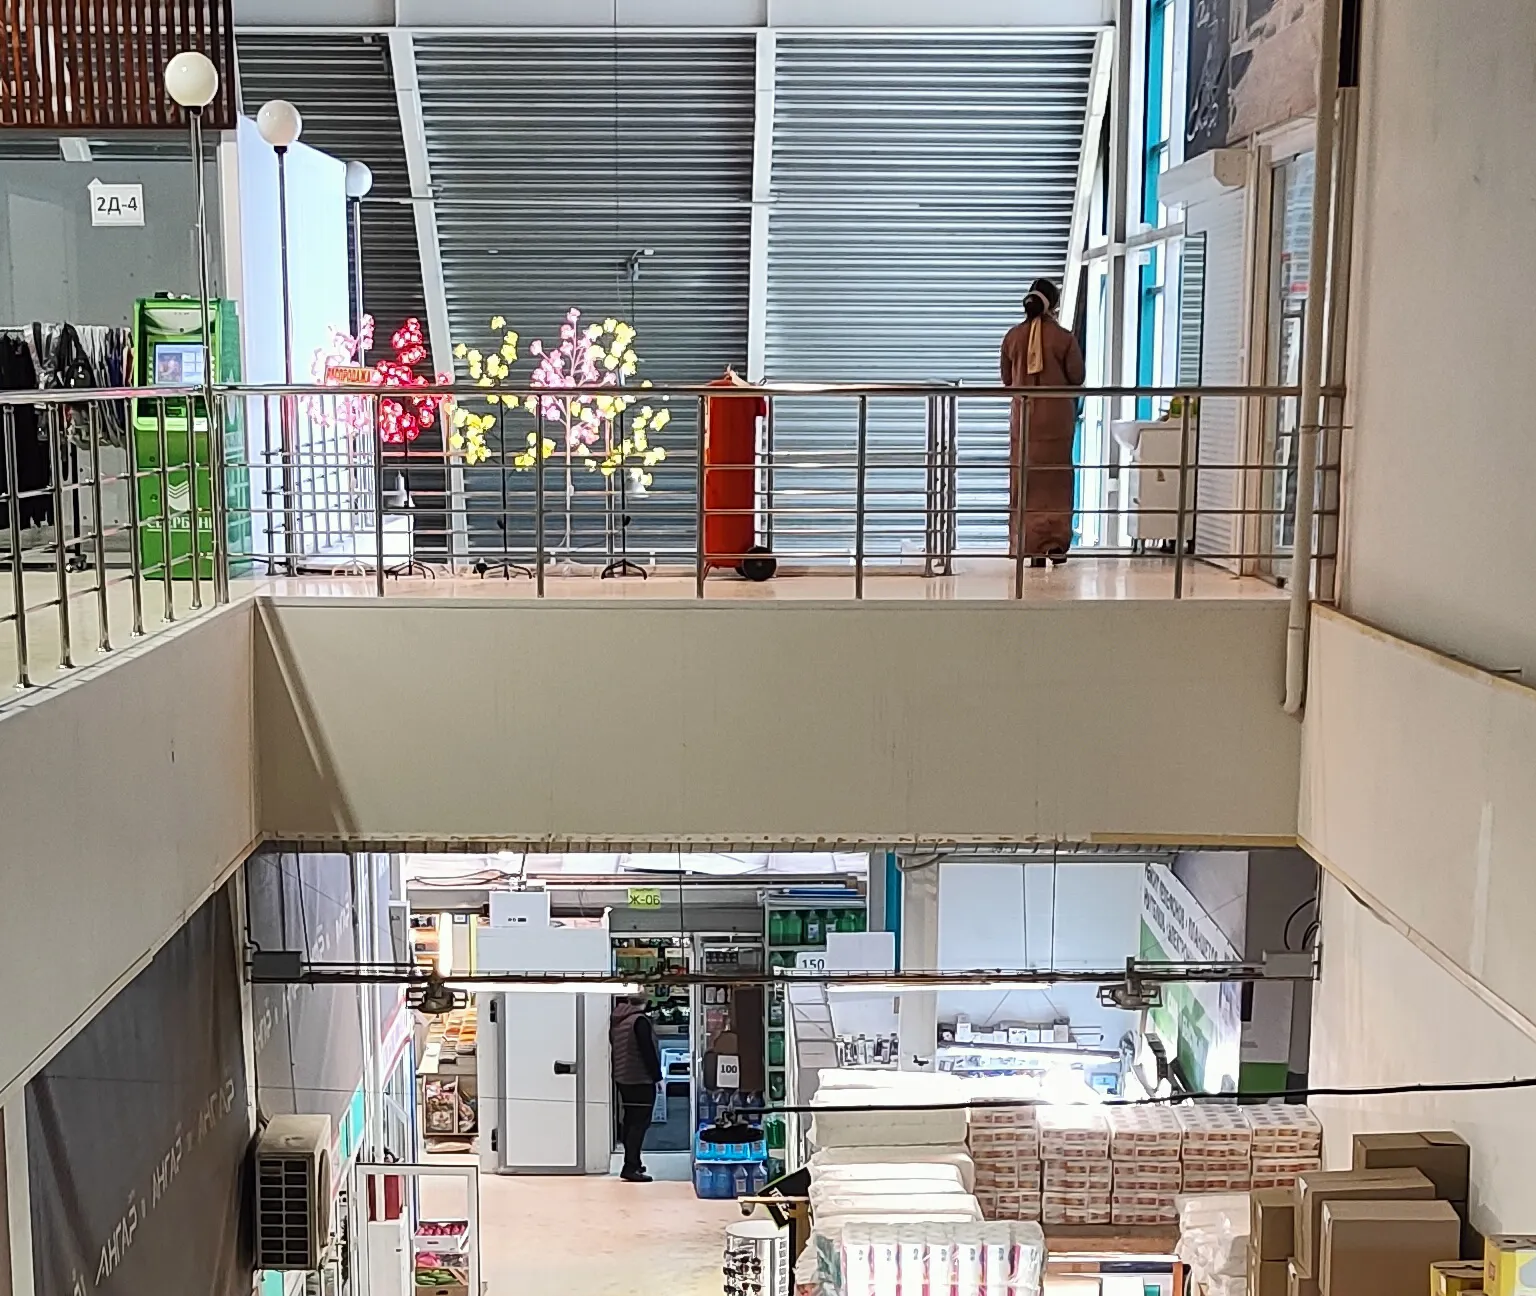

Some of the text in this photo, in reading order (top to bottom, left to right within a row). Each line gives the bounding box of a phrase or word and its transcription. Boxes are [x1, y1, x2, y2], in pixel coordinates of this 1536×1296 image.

[96, 196, 138, 215] 2Д-4
[802, 959, 825, 970] 150
[720, 1064, 738, 1074] 100
[96, 1204, 138, 1286] АНГАР
